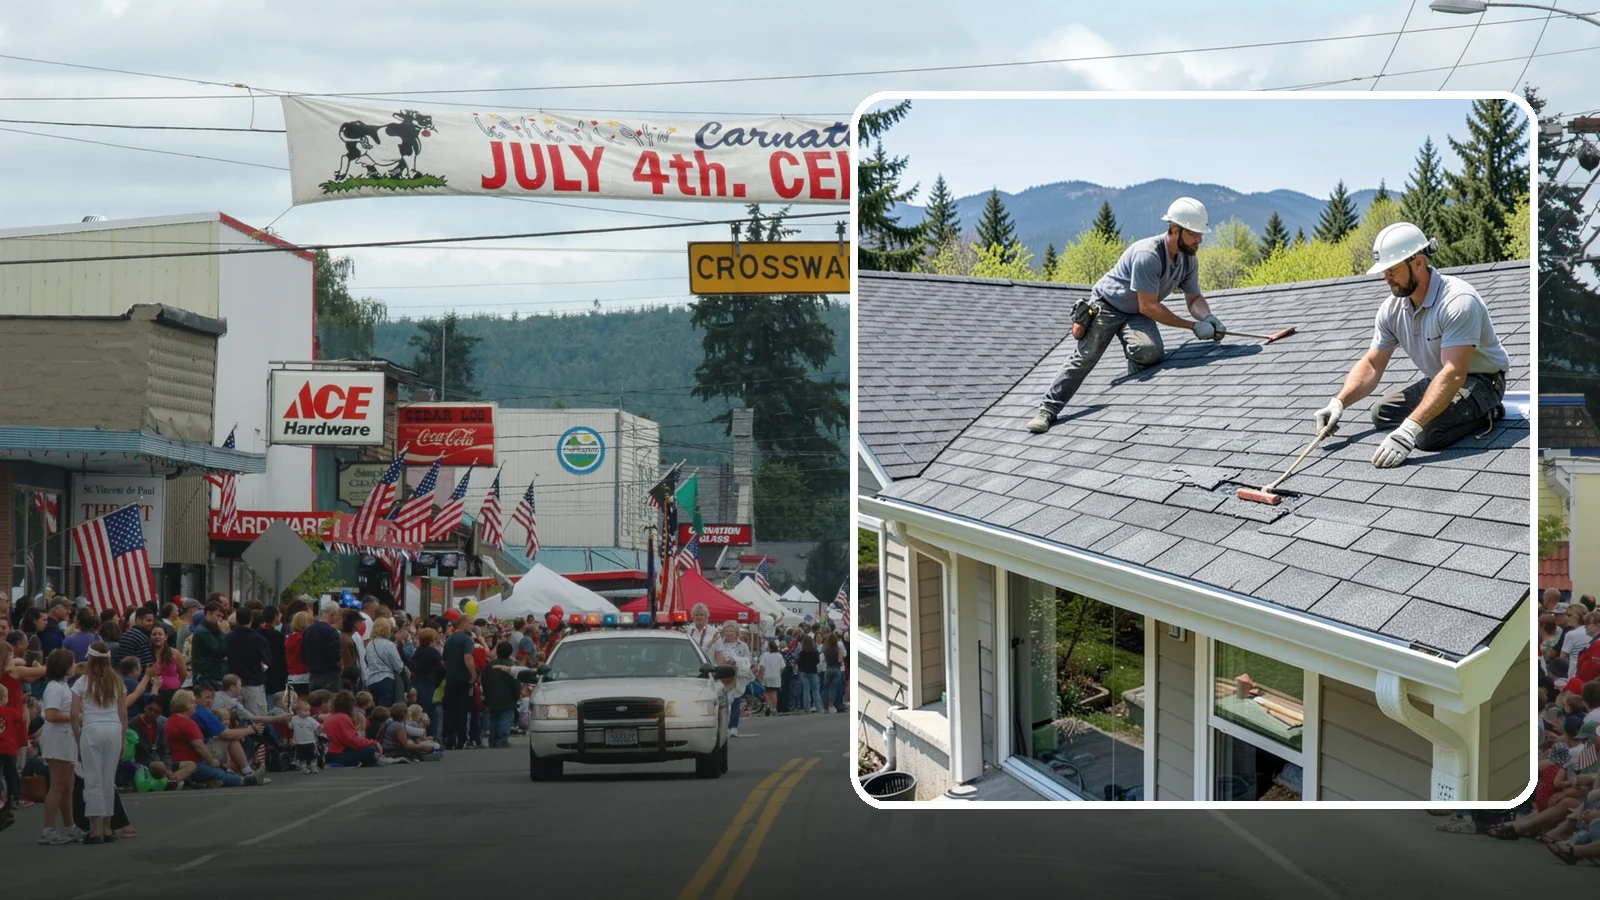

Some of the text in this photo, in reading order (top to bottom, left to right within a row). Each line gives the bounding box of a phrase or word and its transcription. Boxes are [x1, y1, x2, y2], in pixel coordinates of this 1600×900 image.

[695, 121, 850, 149] Carnat
[481, 141, 604, 192] JULY
[632, 150, 746, 197] 4th.
[697, 254, 850, 279] CROSSWA
[282, 380, 373, 420] ACE
[406, 409, 484, 421] CEDAR LOG
[283, 421, 371, 436] Hardware
[96, 485, 124, 494] Vincent
[126, 486, 135, 494] de
[137, 486, 155, 495] Paul
[81, 504, 154, 521] THT
[688, 526, 741, 535] CRNATION
[699, 535, 730, 543] GLASS
